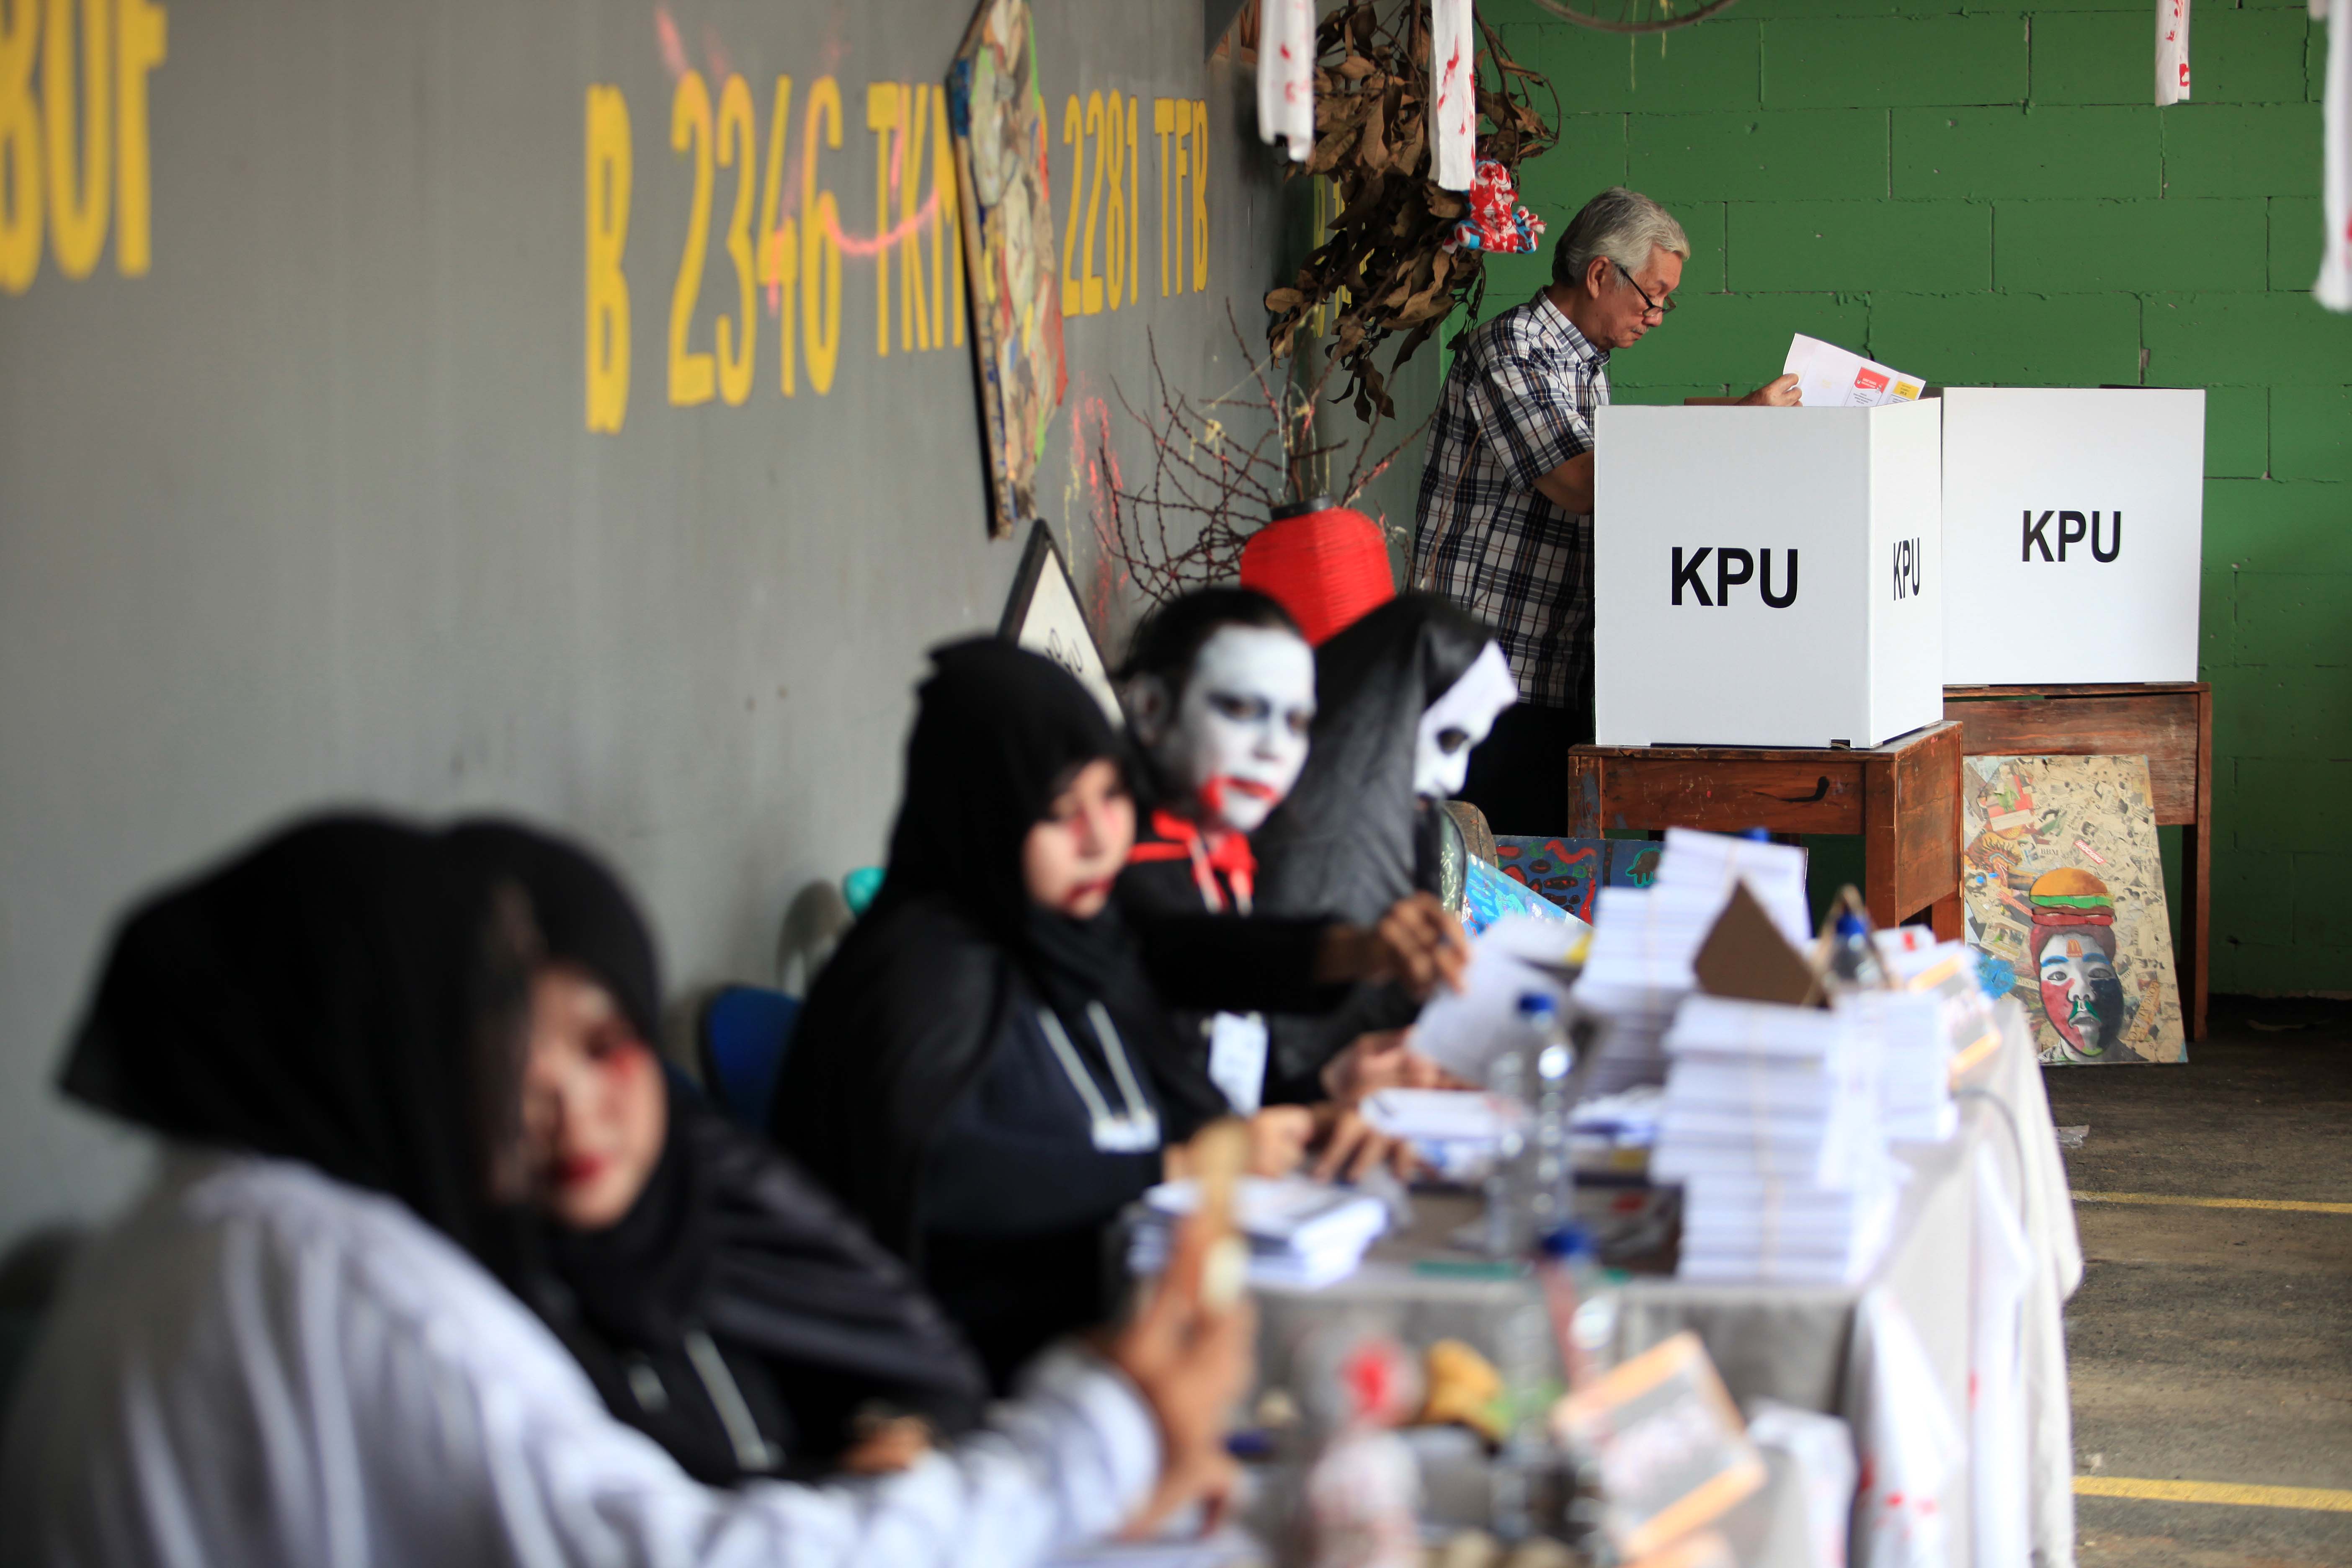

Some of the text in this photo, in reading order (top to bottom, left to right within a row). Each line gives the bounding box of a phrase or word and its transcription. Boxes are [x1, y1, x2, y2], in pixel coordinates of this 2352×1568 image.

[1062, 88, 1139, 317] 2281
[1154, 97, 1209, 297] TFB
[585, 83, 633, 434] B
[667, 69, 843, 407] 2346
[2022, 511, 2121, 563] KPU
[1671, 547, 1798, 609] KPU
[1893, 538, 1920, 601] KPU
[2076, 841, 2104, 863] SHOCKING
